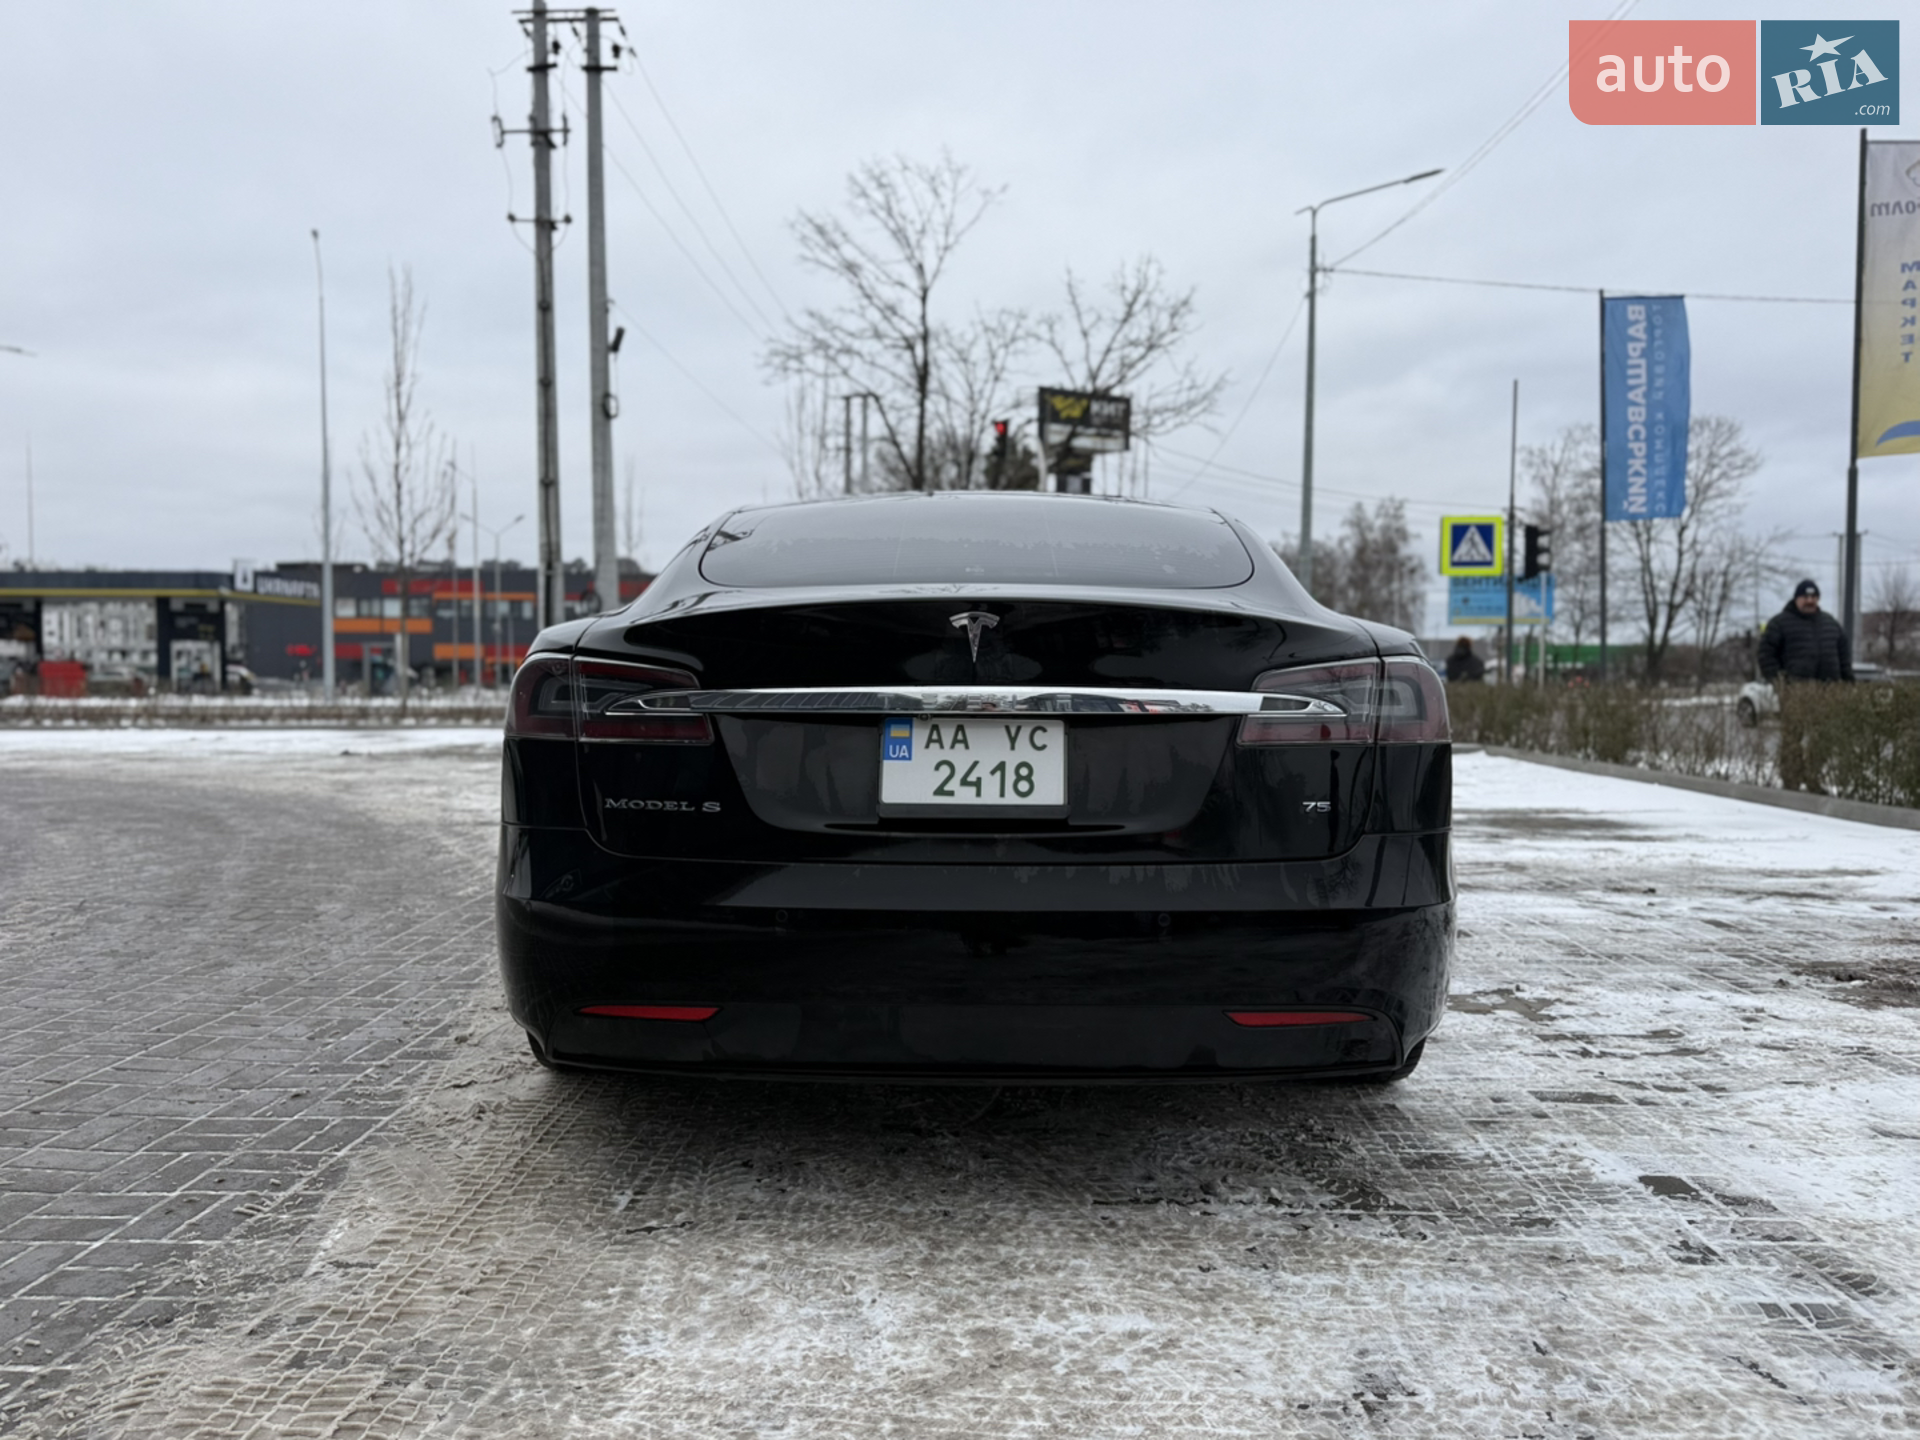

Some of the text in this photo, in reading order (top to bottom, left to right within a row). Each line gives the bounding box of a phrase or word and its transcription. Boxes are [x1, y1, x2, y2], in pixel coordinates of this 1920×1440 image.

[924, 724, 1048, 751] AA YC
[889, 745, 909, 758] UA
[932, 759, 1035, 798] 2418
[604, 798, 721, 813] MODEL S
[1302, 801, 1331, 812] 75
